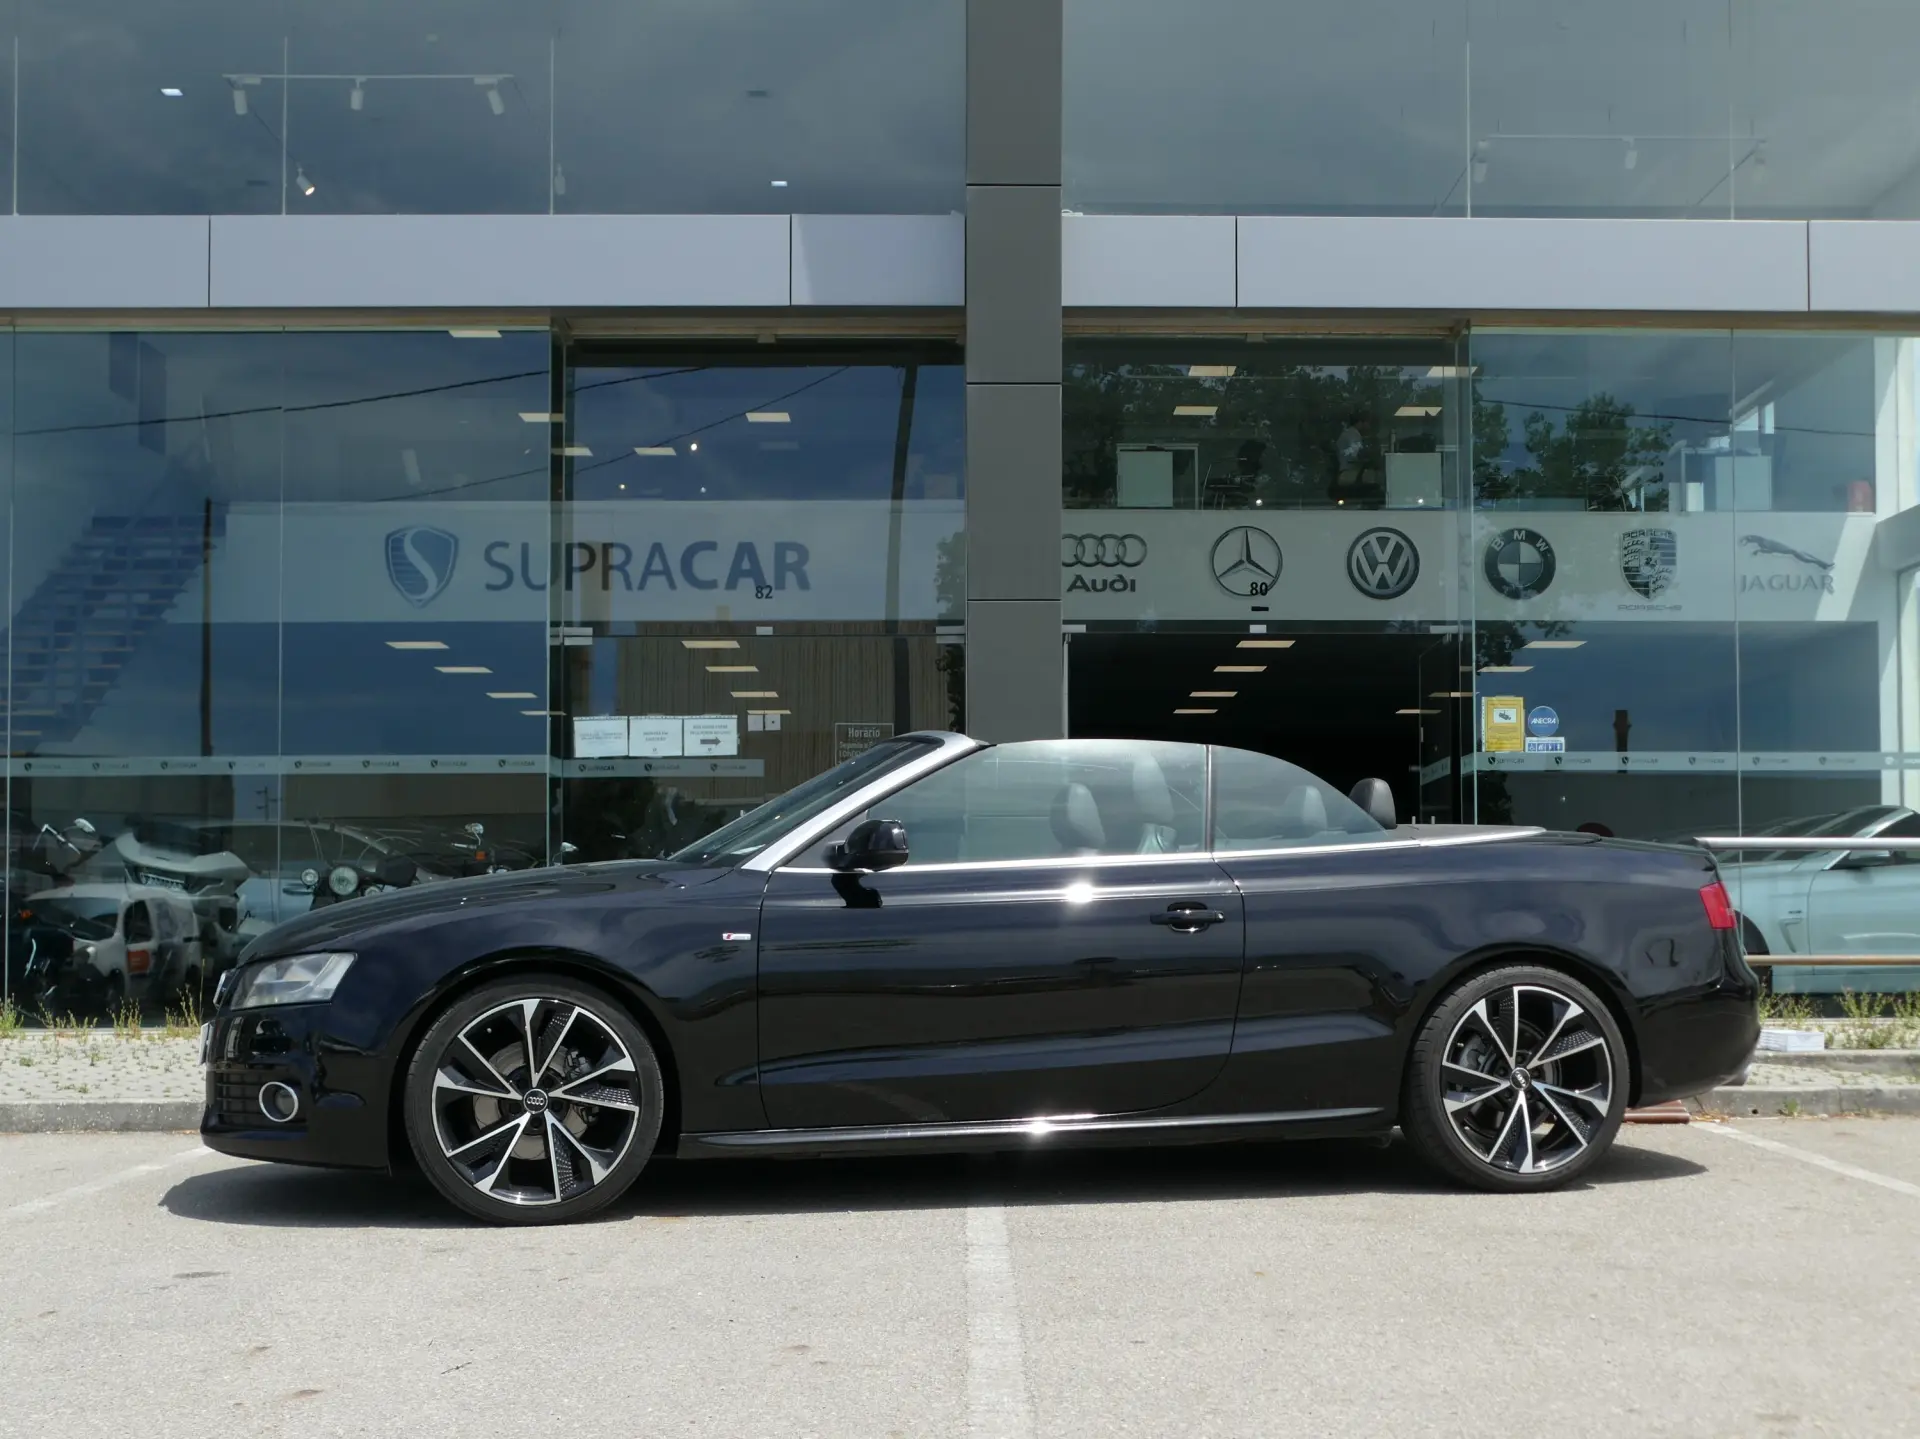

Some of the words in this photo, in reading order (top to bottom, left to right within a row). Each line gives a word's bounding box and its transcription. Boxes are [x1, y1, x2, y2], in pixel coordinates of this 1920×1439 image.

[1491, 530, 1549, 551] BMW
[484, 541, 811, 591] SUPRACAR
[754, 585, 773, 599] 82
[1066, 574, 1136, 593] Audi
[1250, 582, 1268, 596] 80
[1741, 574, 1835, 595] JAGUAR
